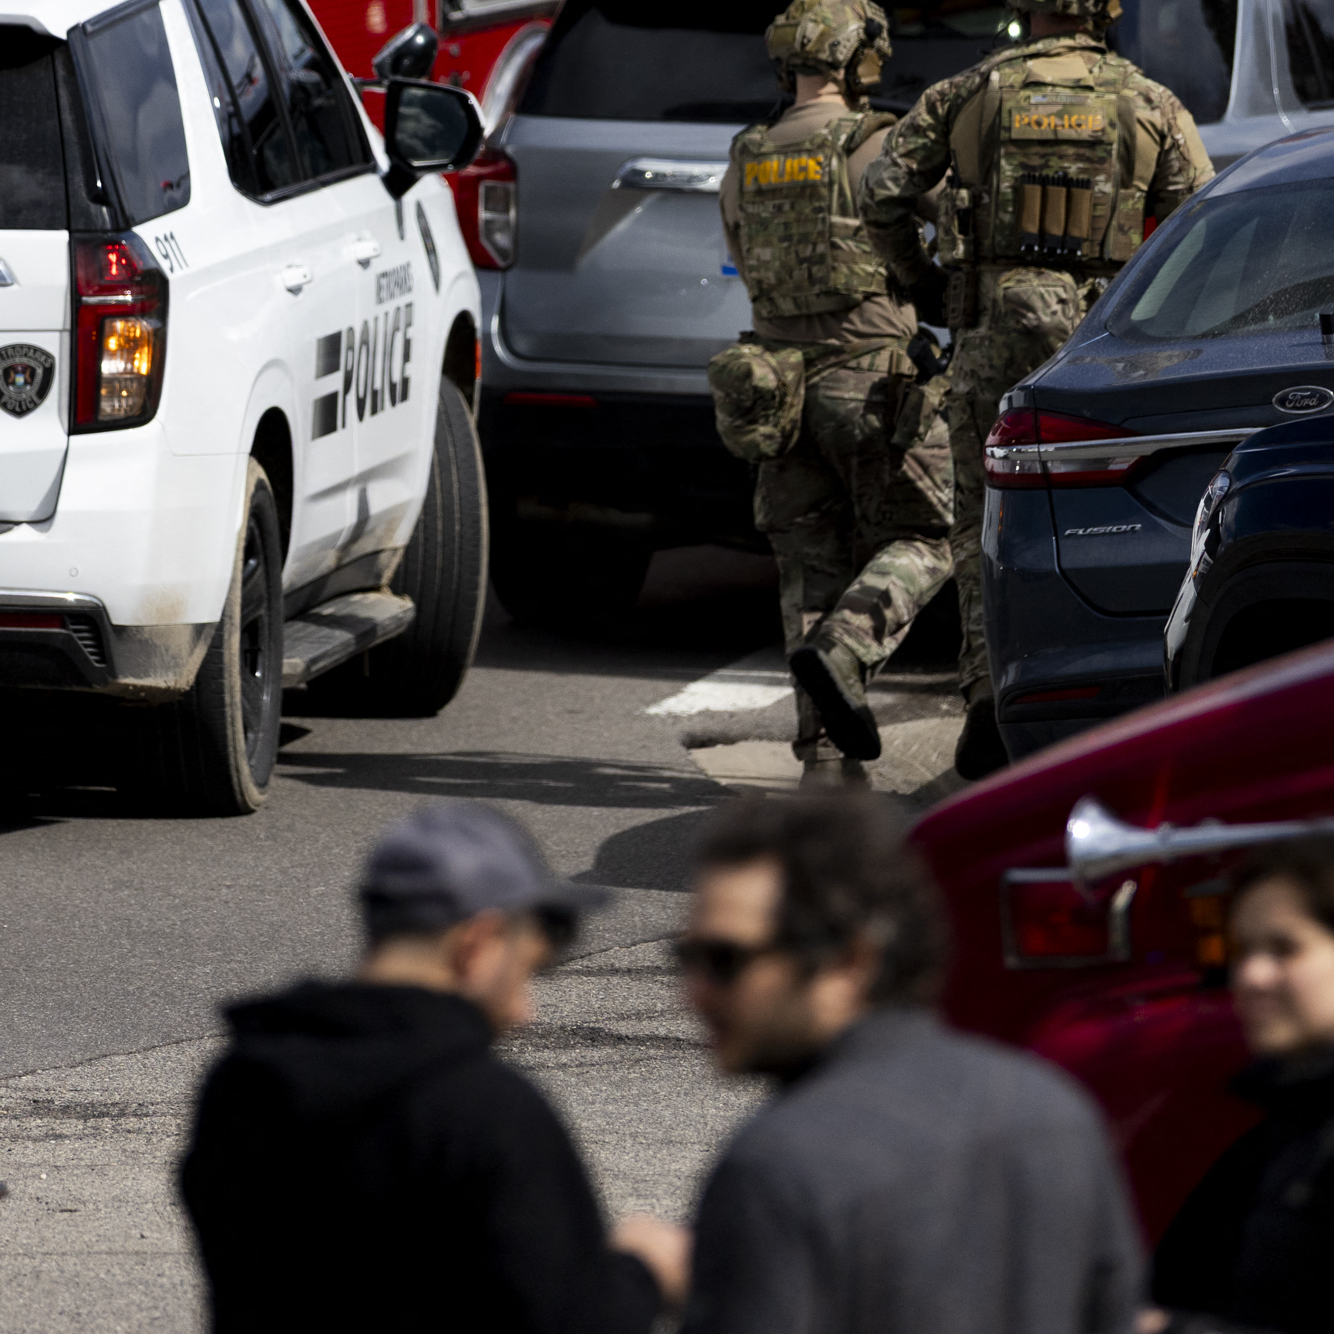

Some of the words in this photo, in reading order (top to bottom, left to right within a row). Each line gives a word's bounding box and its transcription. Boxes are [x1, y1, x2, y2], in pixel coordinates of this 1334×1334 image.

[1013, 113, 1103, 132] POLICE
[744, 155, 824, 187] POLICE
[154, 230, 190, 275] 911
[340, 301, 414, 430] POLICE
[0, 393, 42, 413] POLICE
[1063, 522, 1142, 538] FUSION
